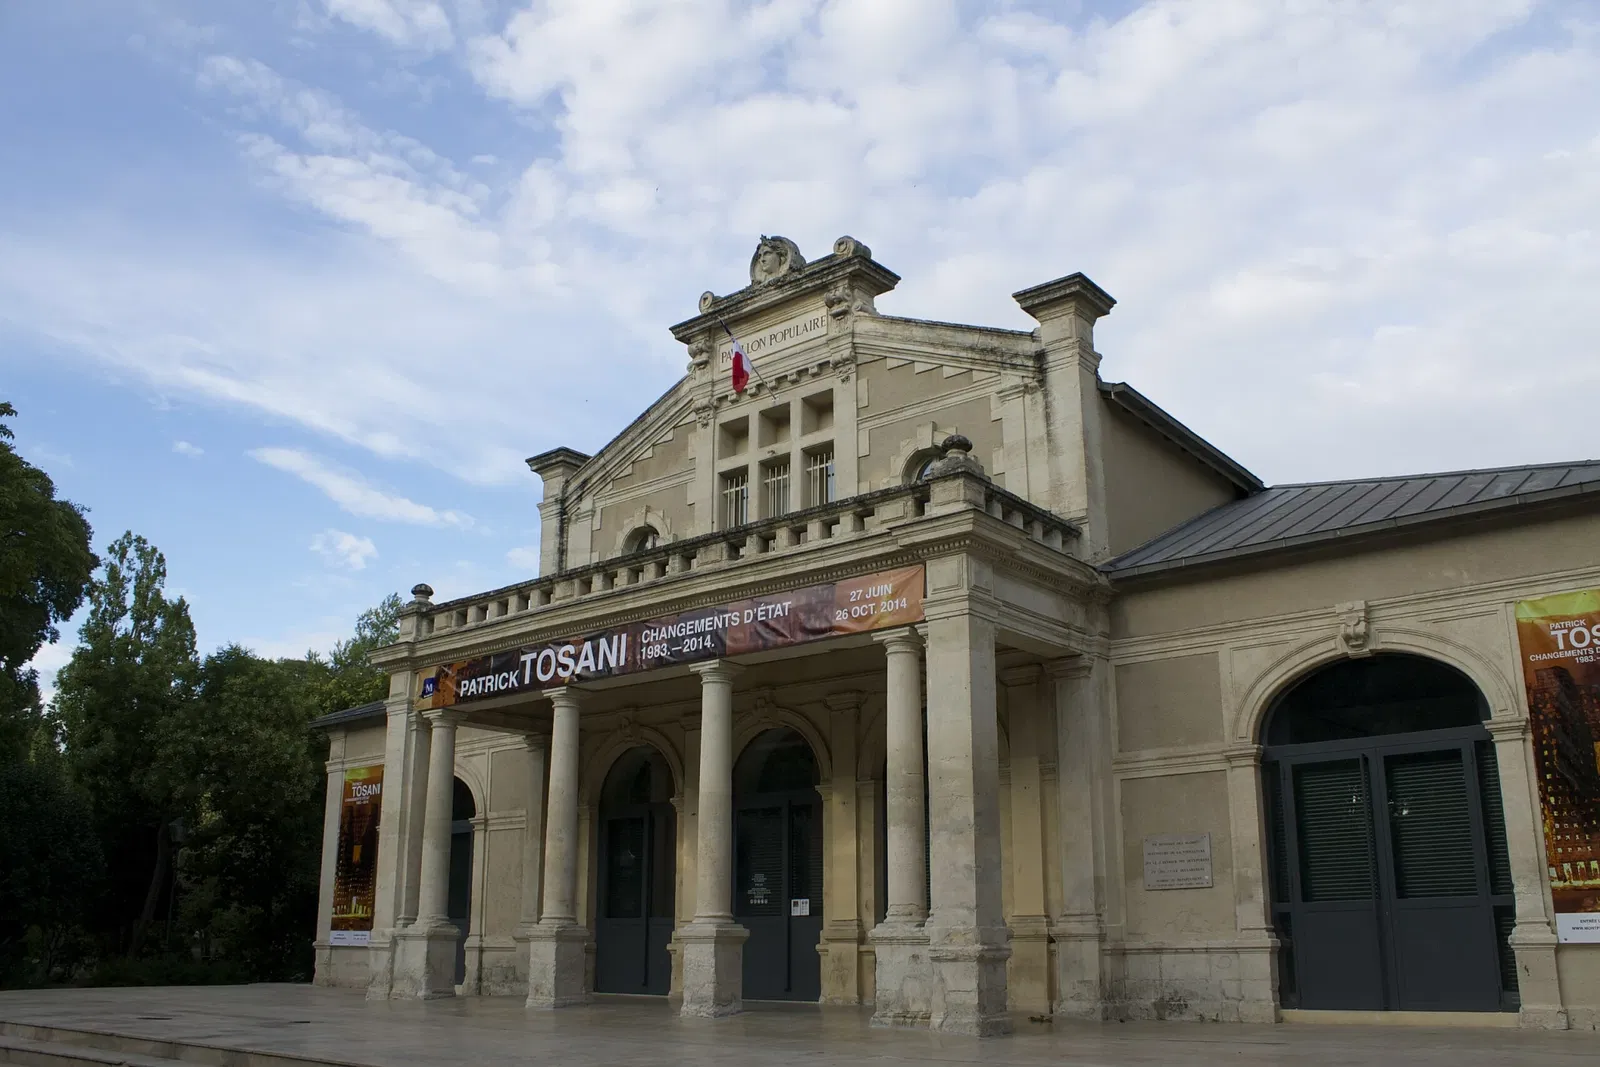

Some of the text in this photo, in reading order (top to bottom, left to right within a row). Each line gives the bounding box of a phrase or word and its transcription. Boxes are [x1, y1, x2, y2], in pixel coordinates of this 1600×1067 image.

[721, 315, 827, 363] PALON POPULAIRE
[850, 583, 893, 602] 27 JUIN
[835, 599, 907, 621] 26 OCT. 2014
[641, 601, 792, 643] CHANGEMENTS D'ÉTAT
[1549, 619, 1586, 630] PATRICK
[1529, 647, 1594, 662] CHANGEMENTS
[460, 633, 627, 697] PATRICK TOSANI
[352, 783, 380, 797] TOSANI
